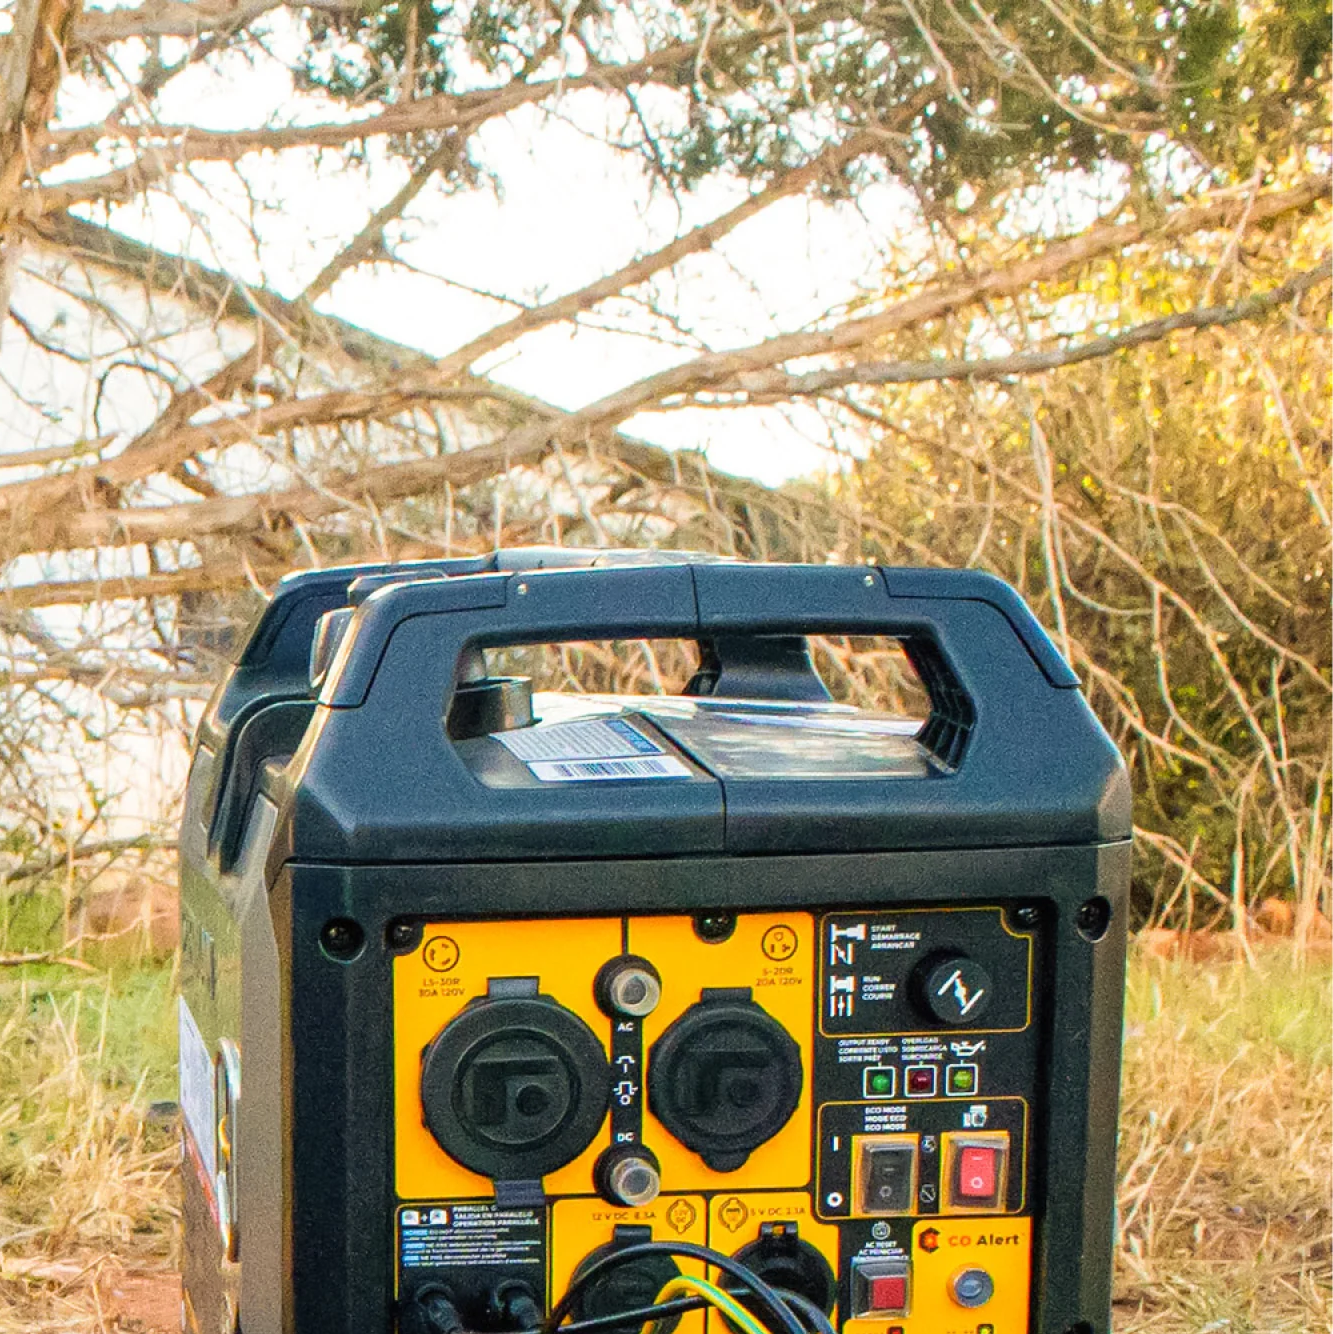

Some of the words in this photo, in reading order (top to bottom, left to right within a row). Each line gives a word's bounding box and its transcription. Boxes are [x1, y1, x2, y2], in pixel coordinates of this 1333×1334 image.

[617, 1022, 634, 1032] AC
[617, 1132, 634, 1142] DC
[948, 1234, 972, 1247] CO
[977, 1232, 1020, 1246] Alert
